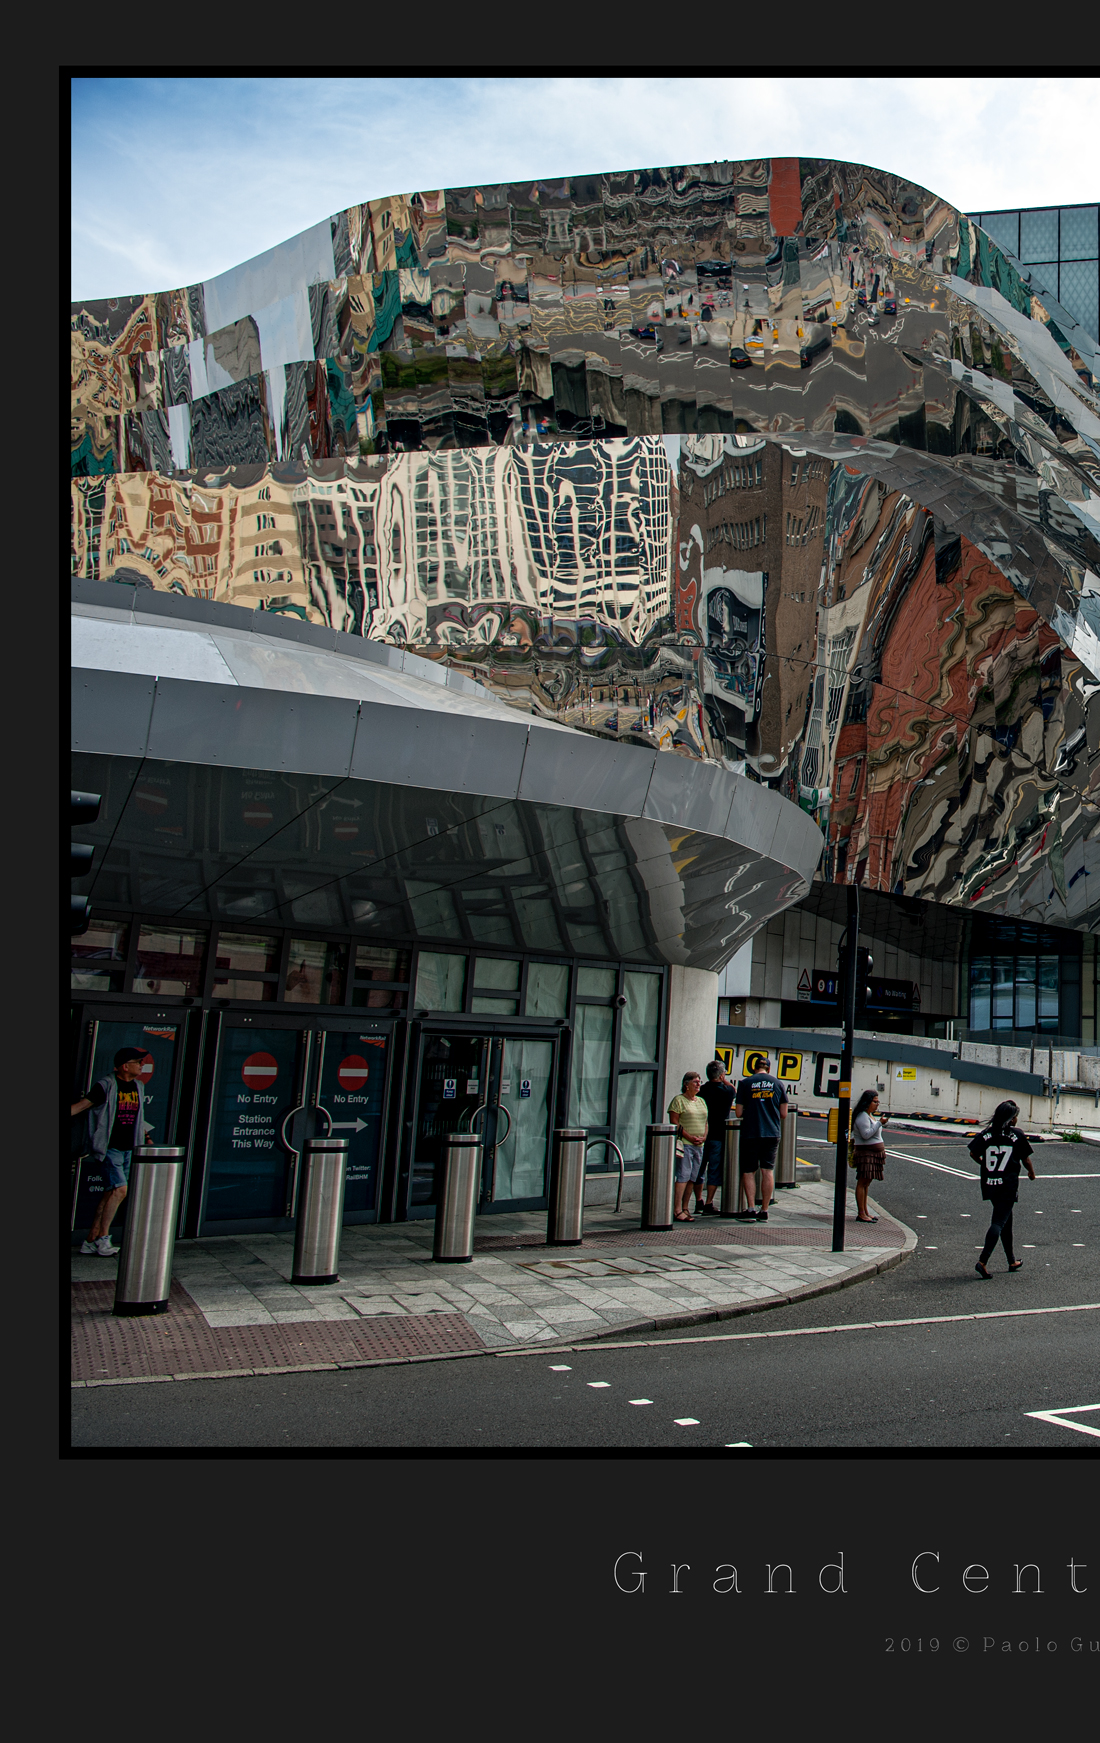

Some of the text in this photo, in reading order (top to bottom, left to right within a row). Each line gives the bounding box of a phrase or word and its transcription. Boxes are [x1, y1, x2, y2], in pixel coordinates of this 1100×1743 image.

[820, 1058, 841, 1093] P
[237, 1094, 278, 1104] No Entry
[334, 1095, 369, 1104] No Entry
[239, 1115, 272, 1124] Station
[233, 1127, 275, 1136] Entrance
[232, 1140, 274, 1149] This Way
[985, 1145, 1013, 1172] 67
